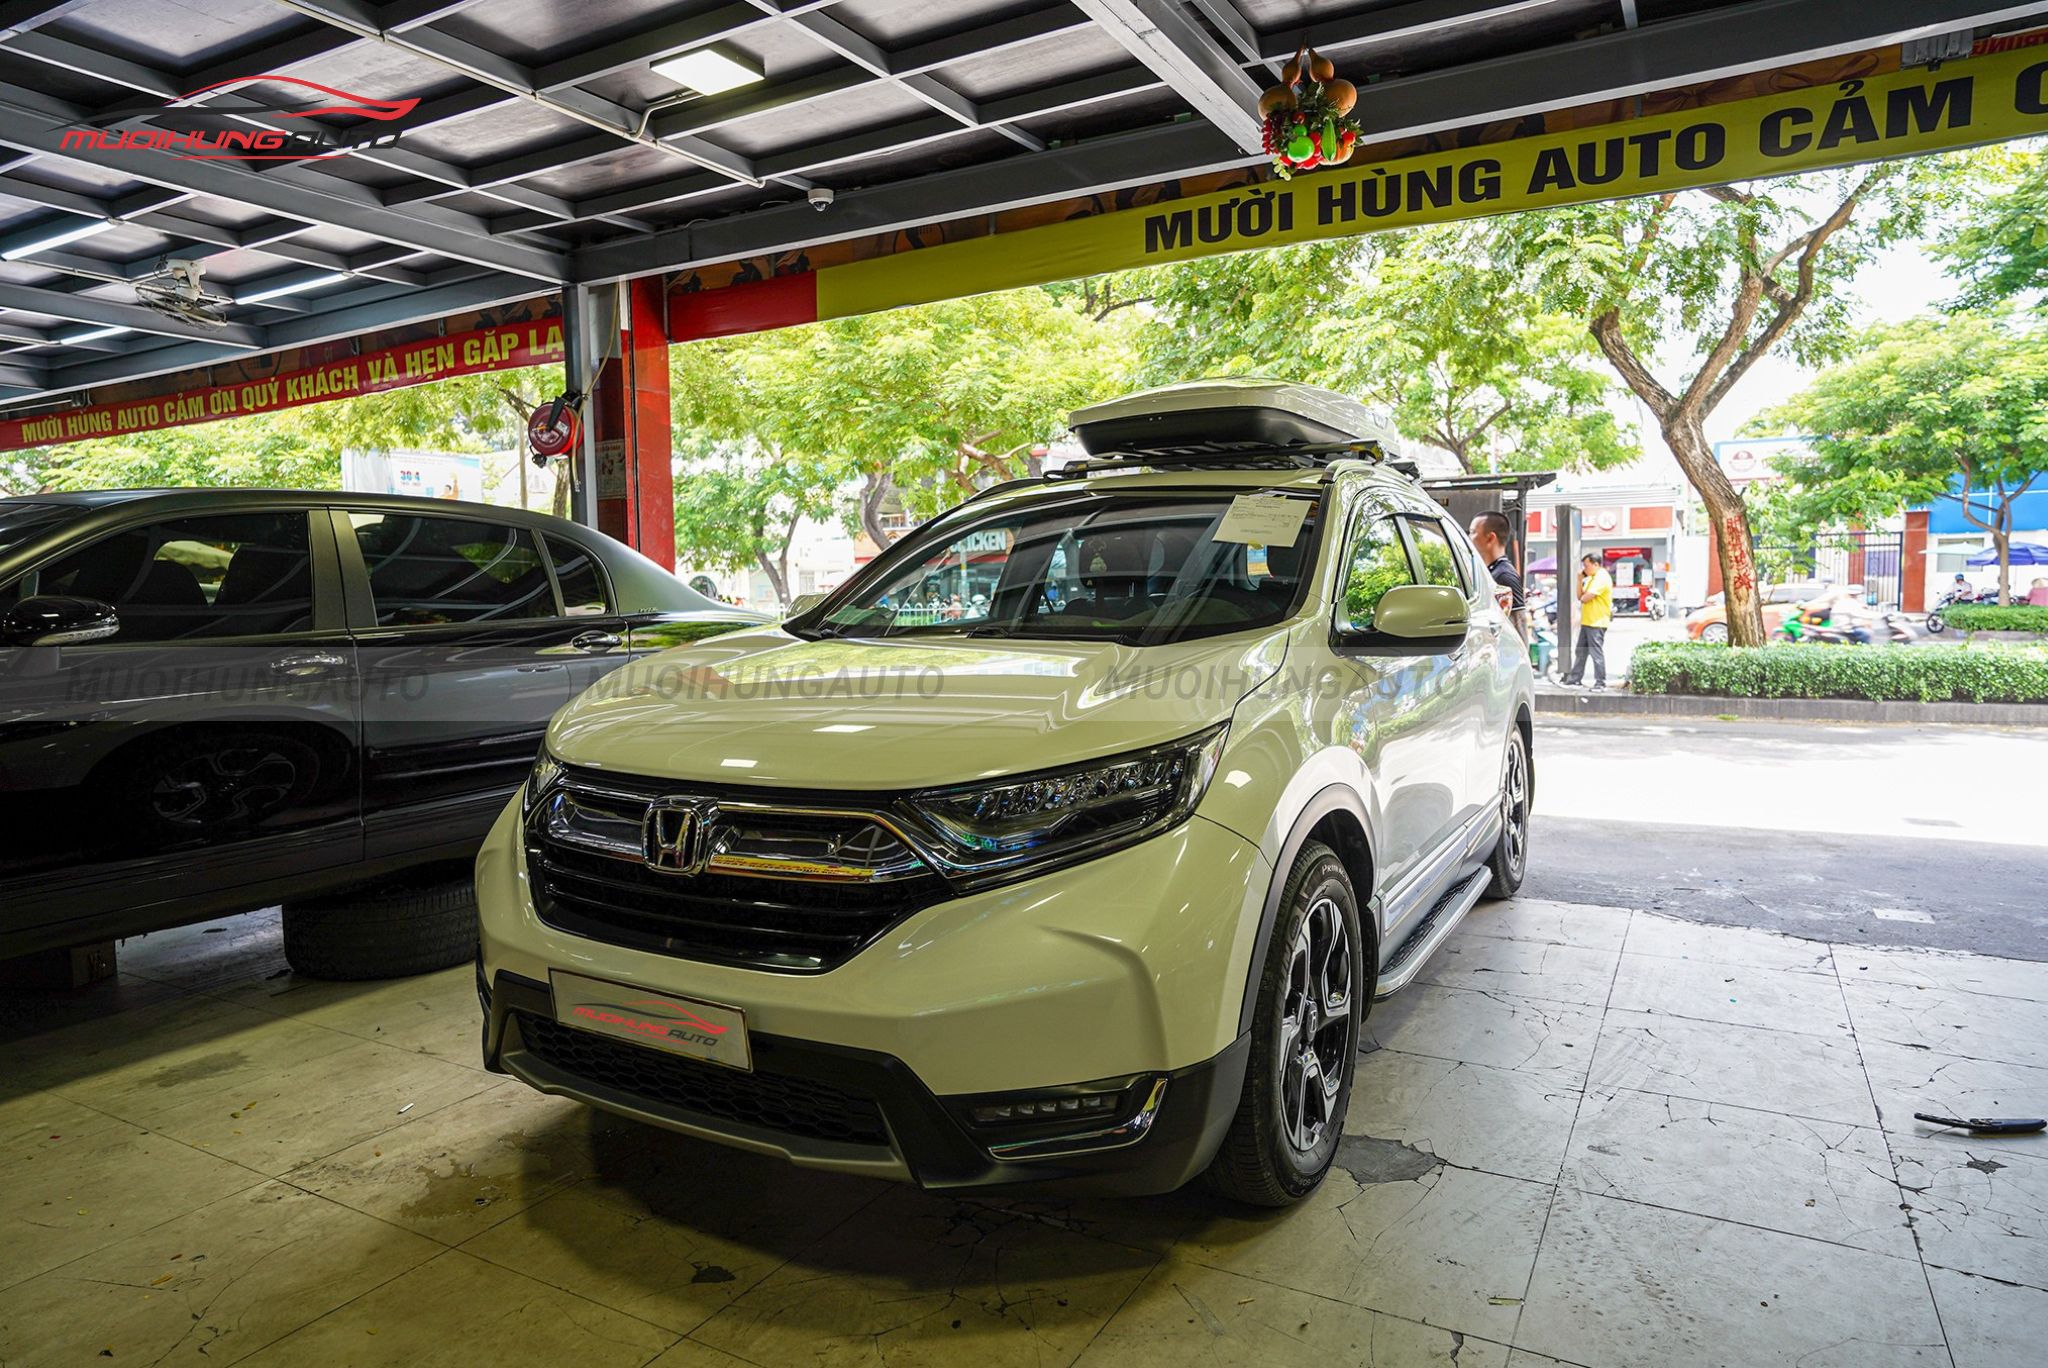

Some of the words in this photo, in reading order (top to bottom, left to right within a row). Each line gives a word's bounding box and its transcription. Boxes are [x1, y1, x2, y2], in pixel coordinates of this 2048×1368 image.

[1145, 190, 1293, 252] MƯỜI
[1317, 158, 1502, 226] HÙNG
[1526, 122, 1726, 195] AUTO
[1759, 76, 1974, 157] CẢM
[21, 413, 64, 443] MƯỜI
[67, 408, 112, 435] HÙNG
[117, 404, 160, 430] AUTO
[164, 393, 206, 423] CẢM
[210, 389, 237, 415] ƠN
[286, 365, 360, 402] KHÁCH
[367, 352, 399, 385] VÀ
[405, 343, 455, 380] HẸN
[463, 331, 519, 369] GẶP
